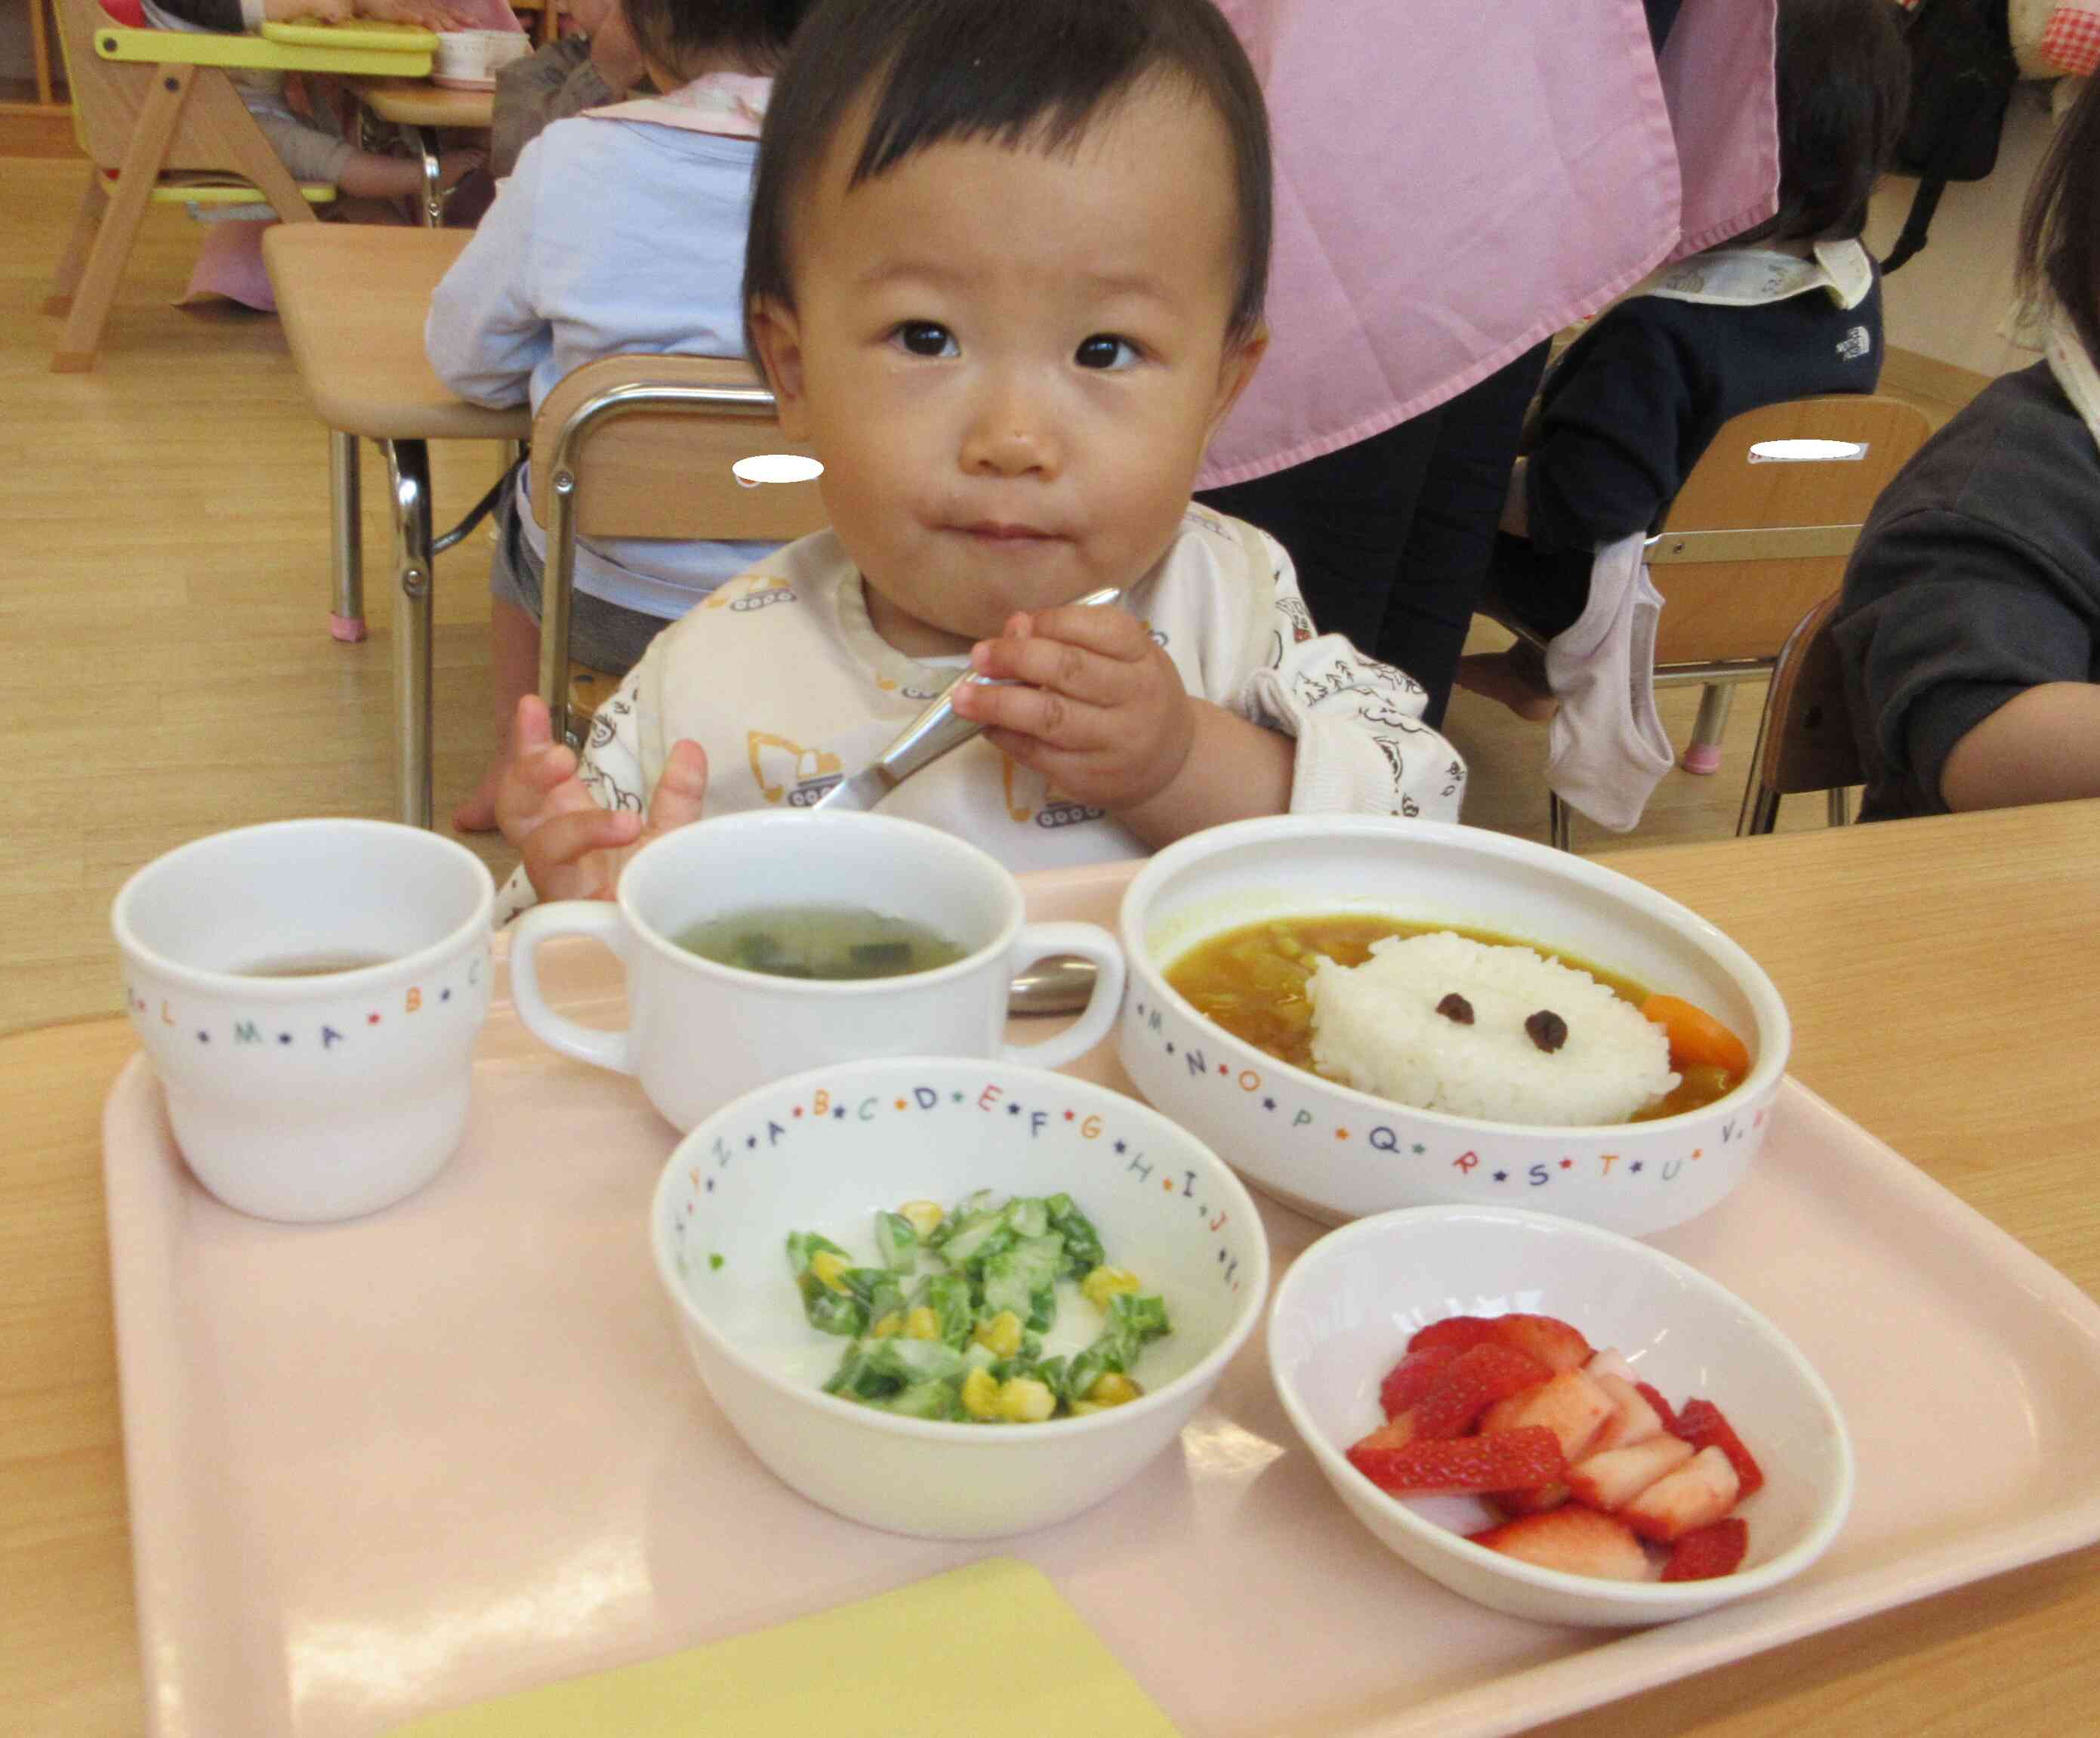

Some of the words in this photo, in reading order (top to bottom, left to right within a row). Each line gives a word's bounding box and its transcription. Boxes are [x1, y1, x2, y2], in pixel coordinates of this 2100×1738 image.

[235, 1021, 261, 1043] M
[322, 1025, 342, 1049] A
[406, 986, 423, 1014] B
[768, 1121, 785, 1146] A
[813, 1088, 830, 1116] B
[858, 1097, 879, 1121] C
[913, 1086, 937, 1110] D
[977, 1084, 1003, 1112] E
[1031, 1112, 1048, 1138] F
[1081, 1115, 1101, 1139] G
[1127, 1153, 1154, 1183] H
[1183, 1171, 1196, 1197] I
[1186, 1049, 1207, 1076] N
[1238, 1070, 1262, 1092] O
[1293, 1109, 1312, 1127] P
[1369, 1126, 1401, 1154] Q
[1452, 1150, 1479, 1175] R
[1528, 1164, 1550, 1186] S
[1599, 1154, 1620, 1175] T
[1661, 1159, 1682, 1181] U
